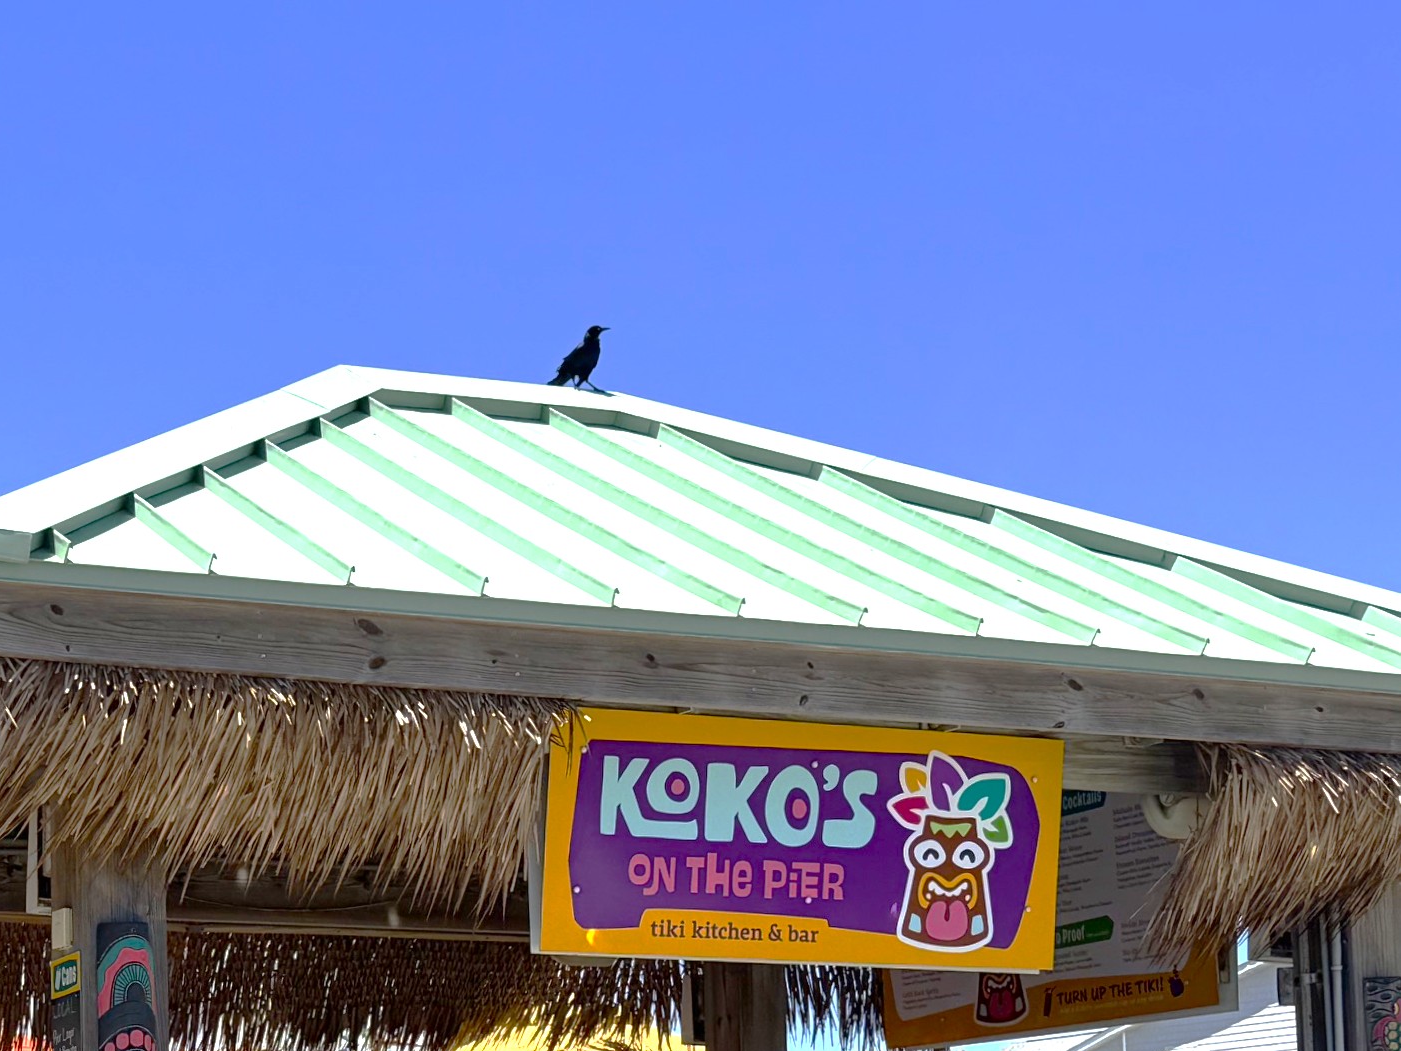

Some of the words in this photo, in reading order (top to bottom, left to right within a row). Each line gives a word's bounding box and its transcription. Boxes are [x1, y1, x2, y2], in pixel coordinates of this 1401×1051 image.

[599, 755, 878, 848] KOKO'S
[628, 853, 676, 896] ON
[650, 920, 686, 940] tiki
[691, 920, 764, 943] kitchen
[768, 925, 784, 942] &
[788, 924, 819, 944] bar
[1062, 924, 1086, 943] Proof
[1056, 990, 1088, 1006] TURN
[1091, 985, 1106, 1001] UP
[1109, 981, 1133, 999] THE
[1135, 977, 1164, 996] TIKI!
